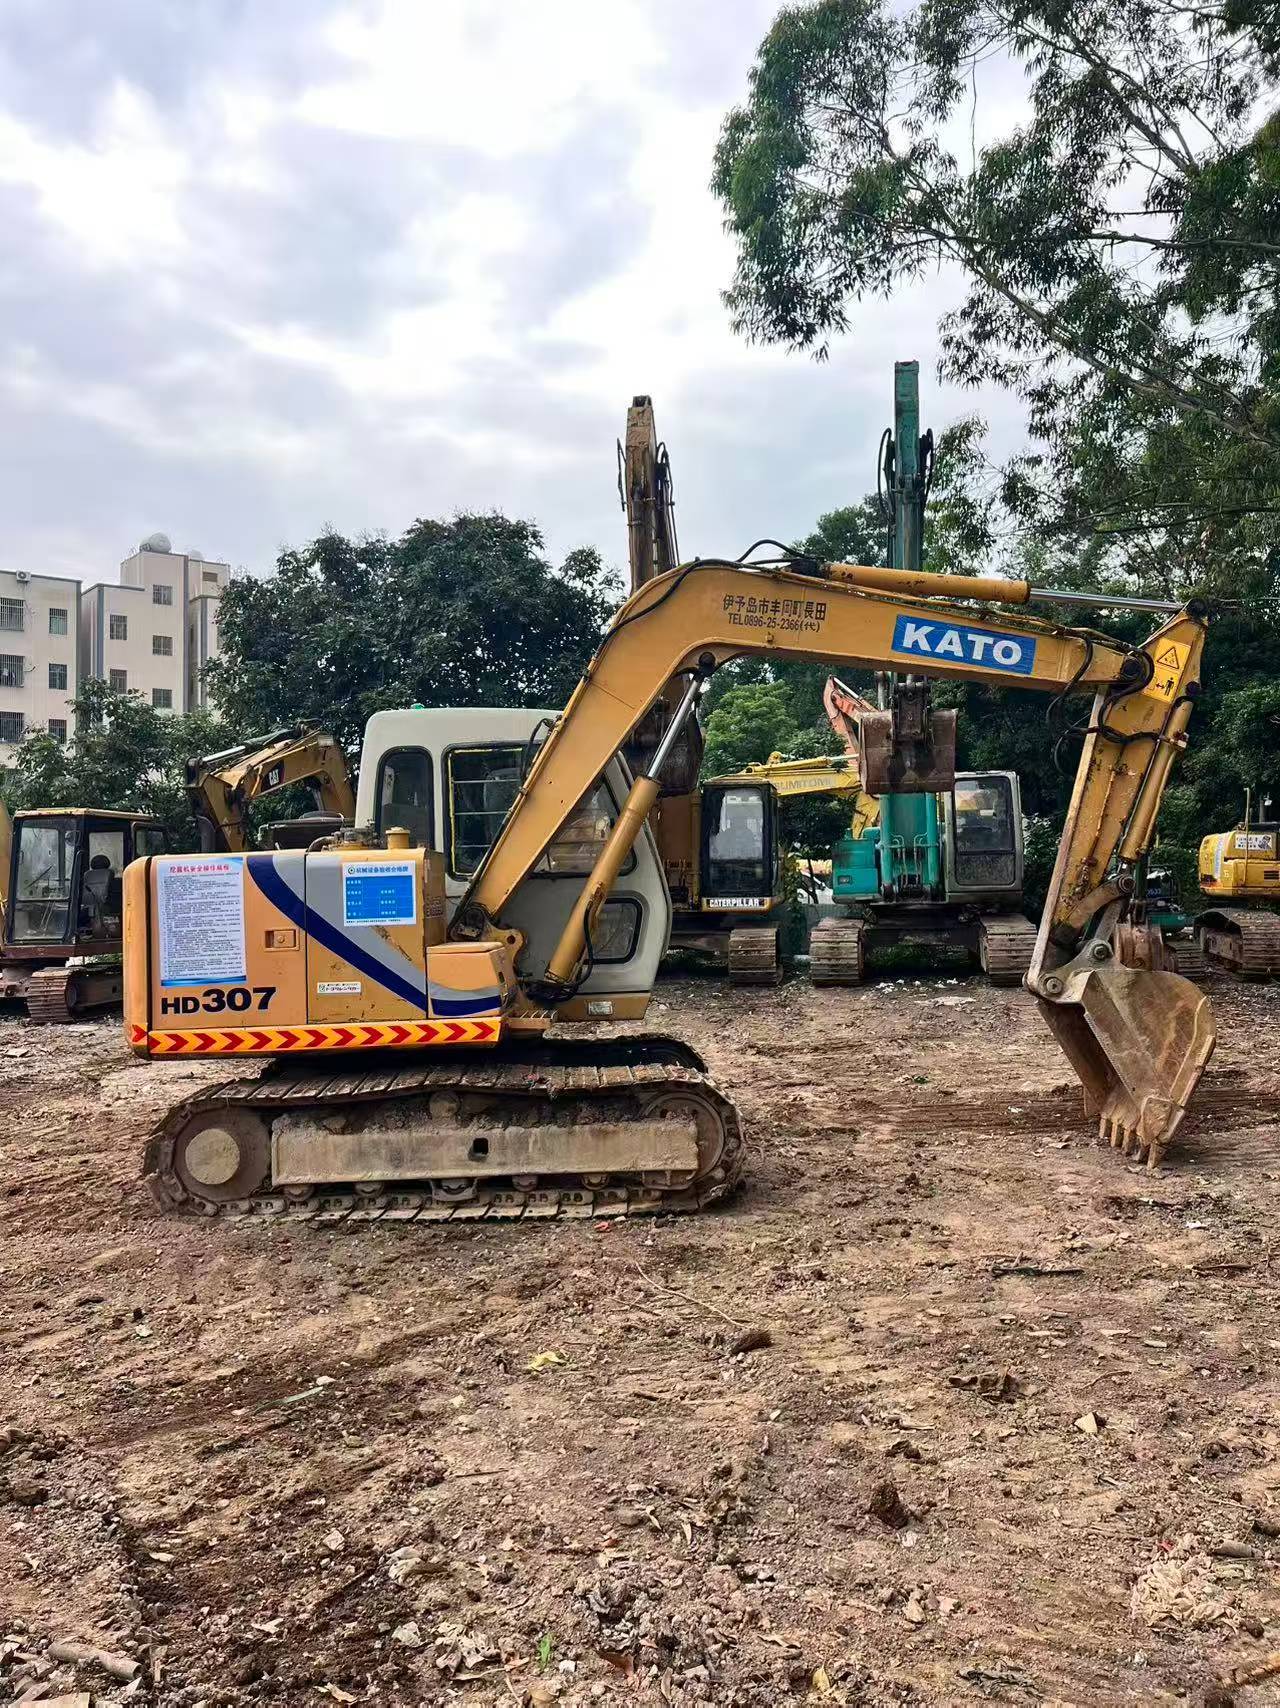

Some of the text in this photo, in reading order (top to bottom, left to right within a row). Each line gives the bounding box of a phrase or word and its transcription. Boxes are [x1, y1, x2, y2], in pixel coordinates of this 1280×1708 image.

[902, 622, 1022, 666] KATO
[269, 769, 279, 786] CAT
[709, 898, 760, 908] CATERPILLAR
[161, 987, 277, 1015] HD307
